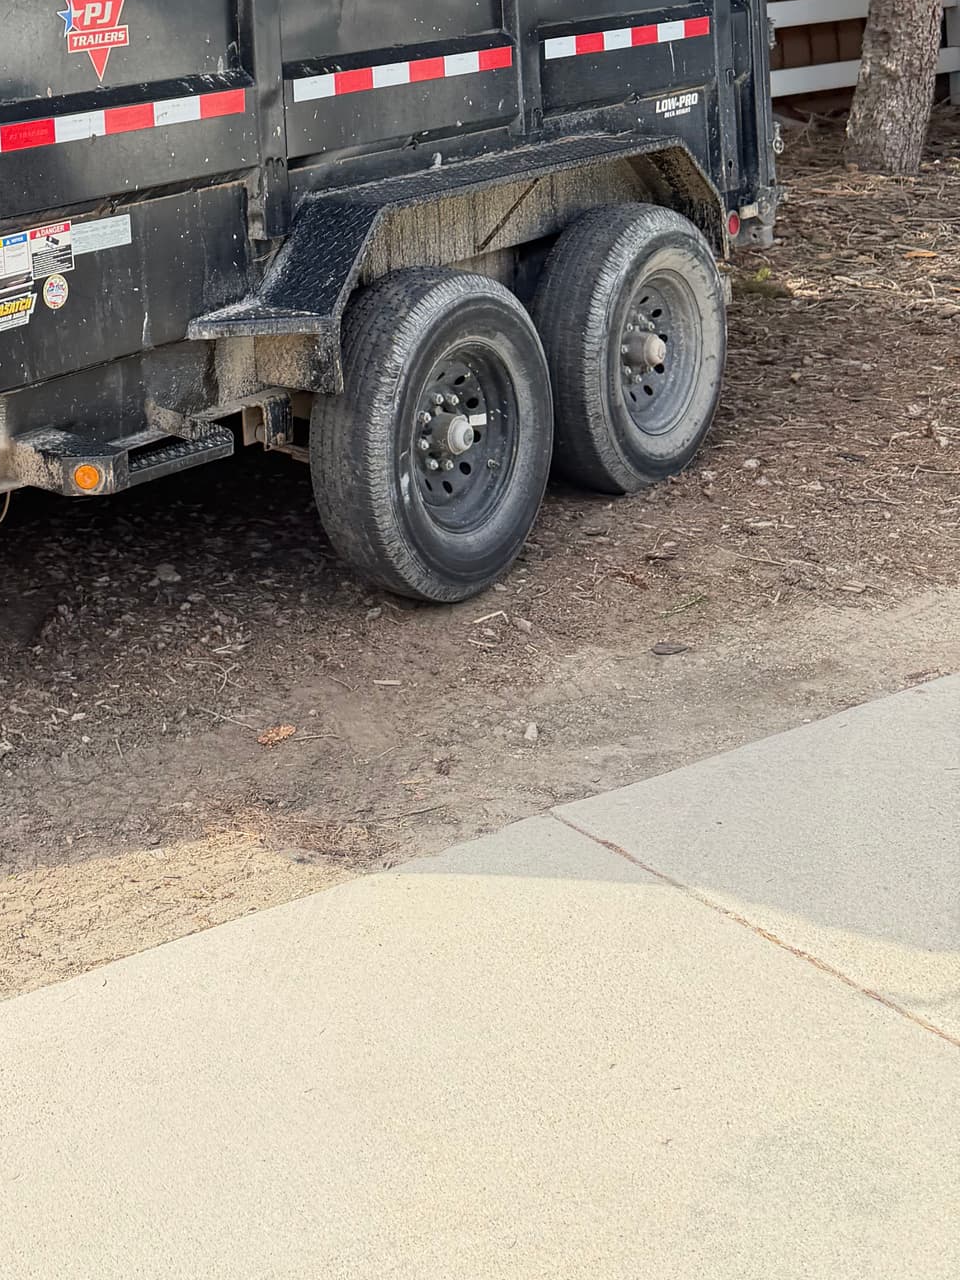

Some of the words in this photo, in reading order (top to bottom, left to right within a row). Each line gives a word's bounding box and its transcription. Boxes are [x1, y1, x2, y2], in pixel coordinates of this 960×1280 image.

[83, 1, 113, 26] PJ
[72, 30, 125, 47] TRAILERS
[40, 224, 65, 237] DANGER
